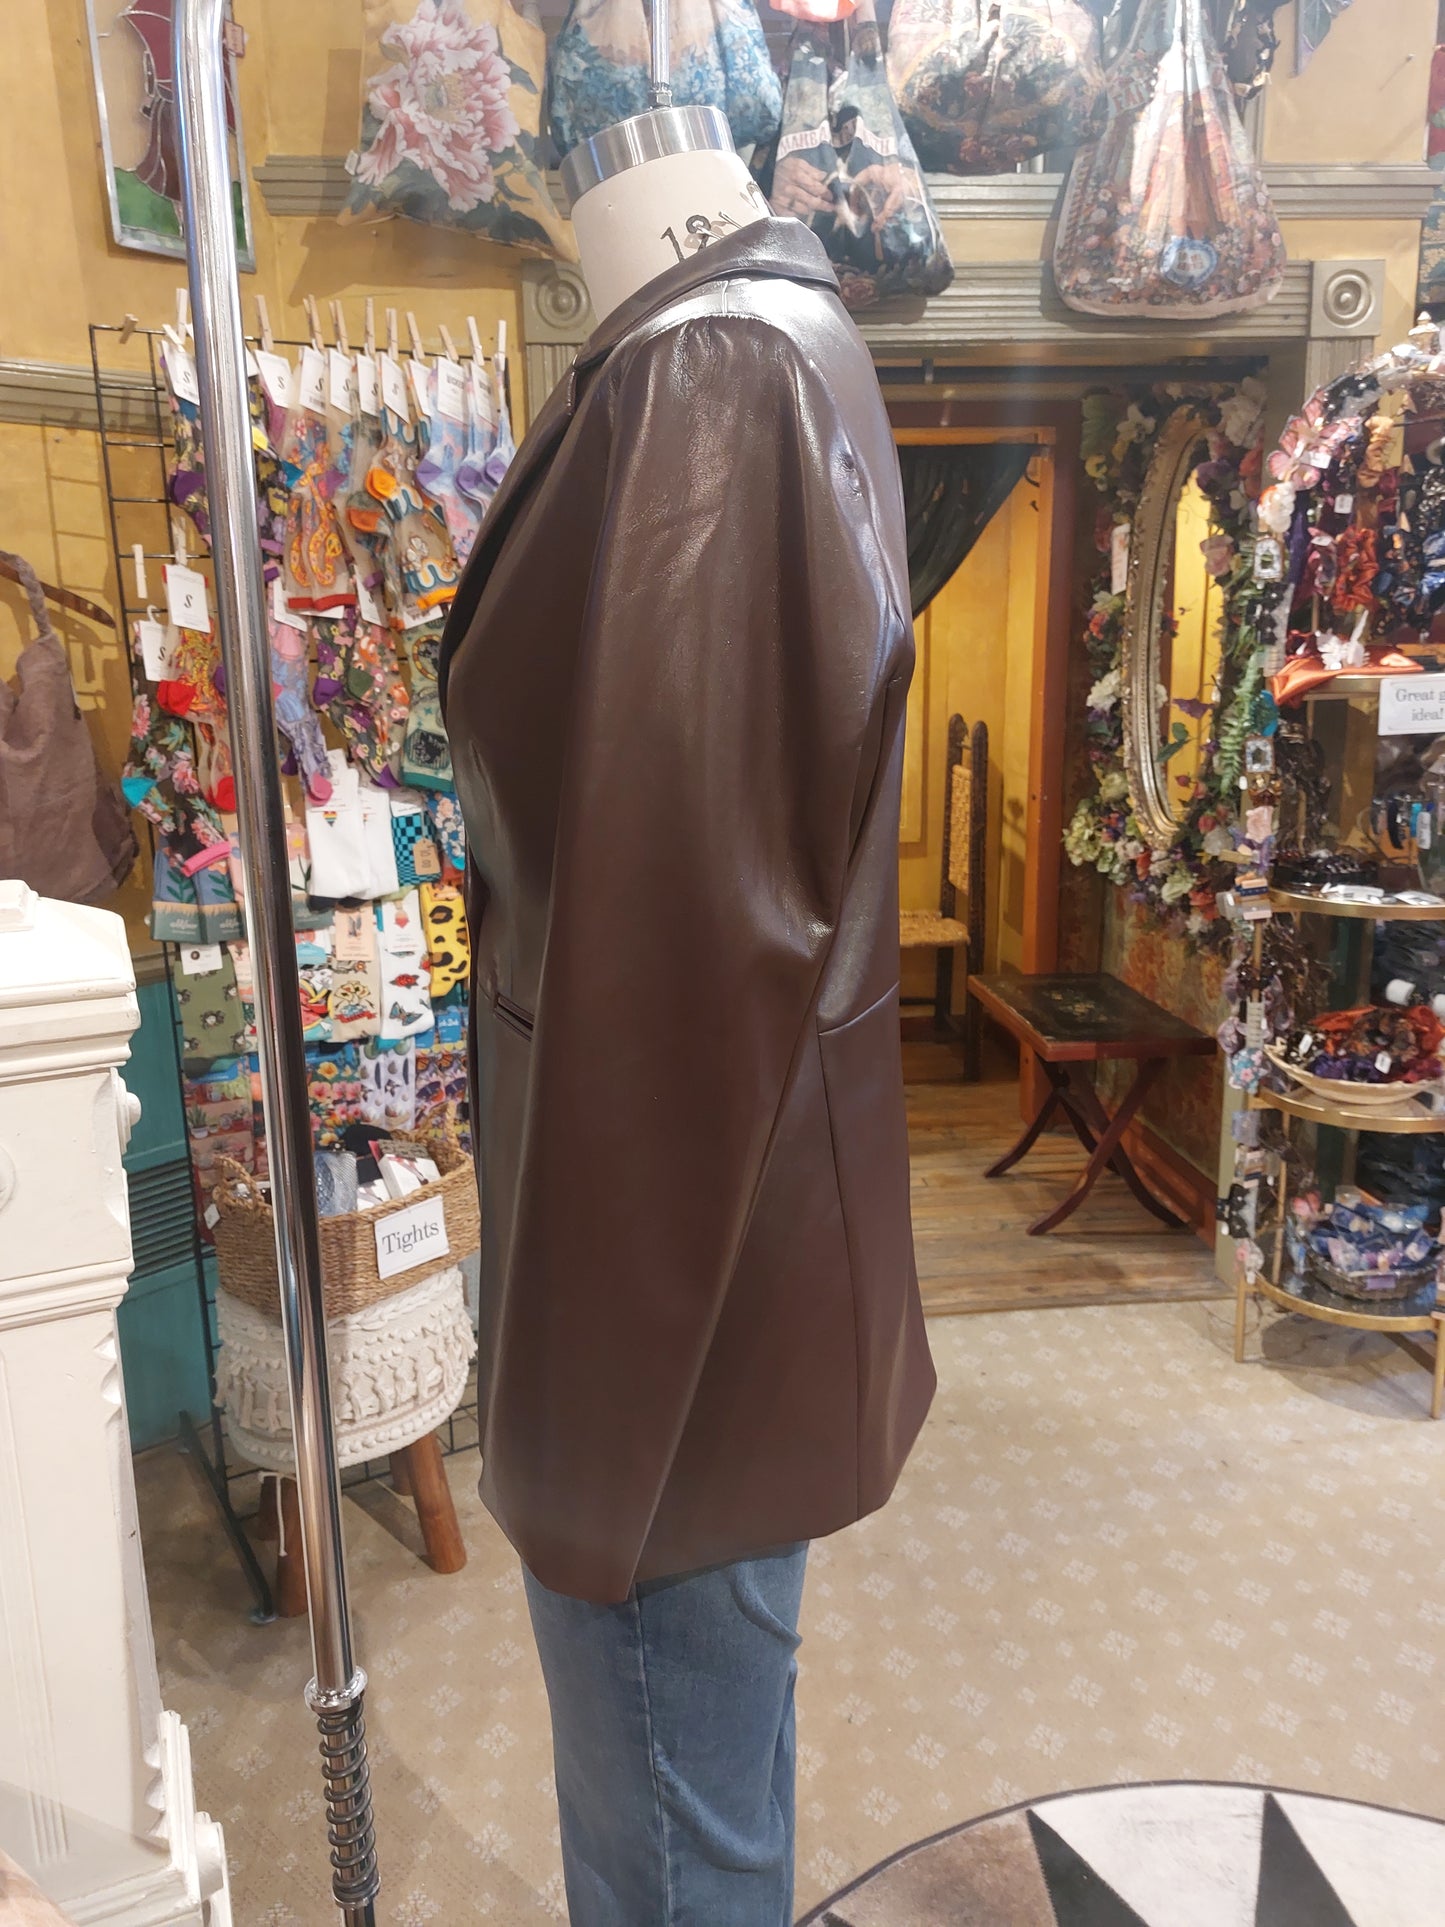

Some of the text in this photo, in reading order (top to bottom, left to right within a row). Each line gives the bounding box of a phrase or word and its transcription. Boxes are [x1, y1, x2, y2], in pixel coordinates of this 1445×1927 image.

[315, 378, 324, 392] S
[184, 594, 193, 608] S
[158, 646, 166, 661] S
[1395, 688, 1434, 702] Great
[1411, 708, 1443, 721] idea!
[382, 1221, 439, 1255] Tights
